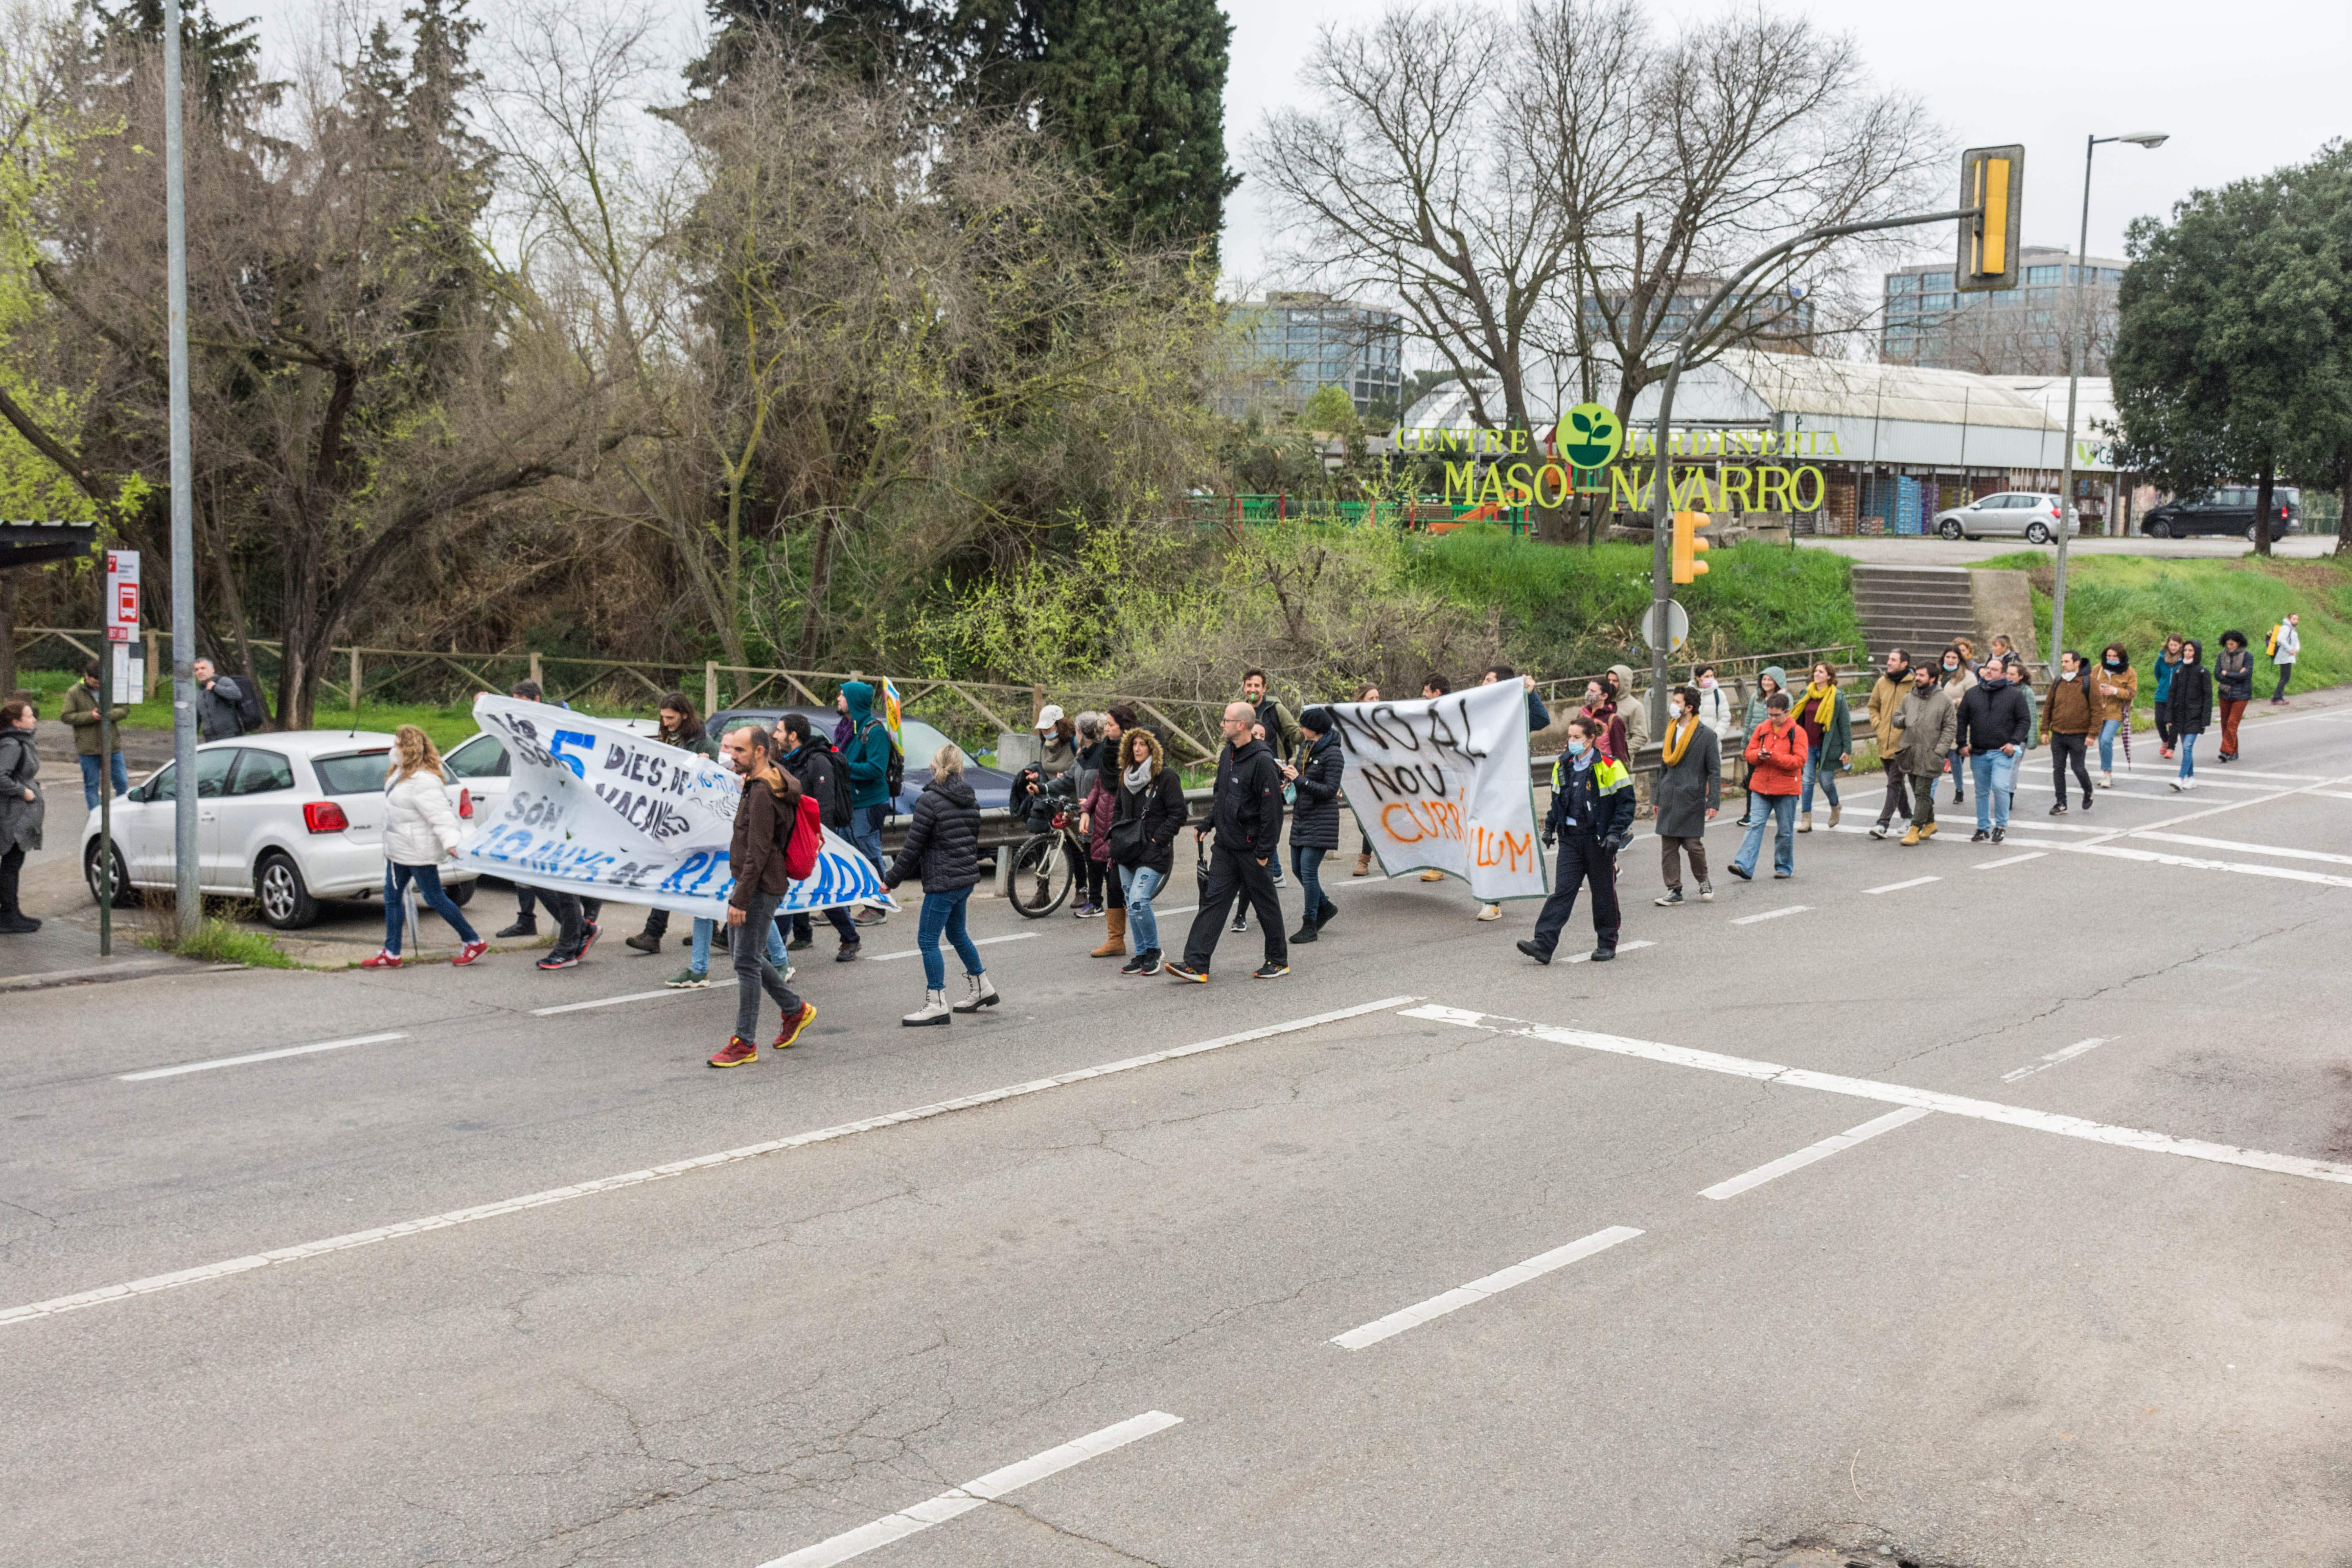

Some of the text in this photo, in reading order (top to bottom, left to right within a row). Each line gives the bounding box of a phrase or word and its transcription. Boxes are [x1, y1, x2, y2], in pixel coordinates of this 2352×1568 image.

[1396, 427, 1842, 459] CENTRE JARDINERIA
[1325, 699, 1487, 767] NO AL
[549, 730, 596, 779] 5
[1360, 763, 1446, 801] NOU
[471, 824, 532, 860] 10
